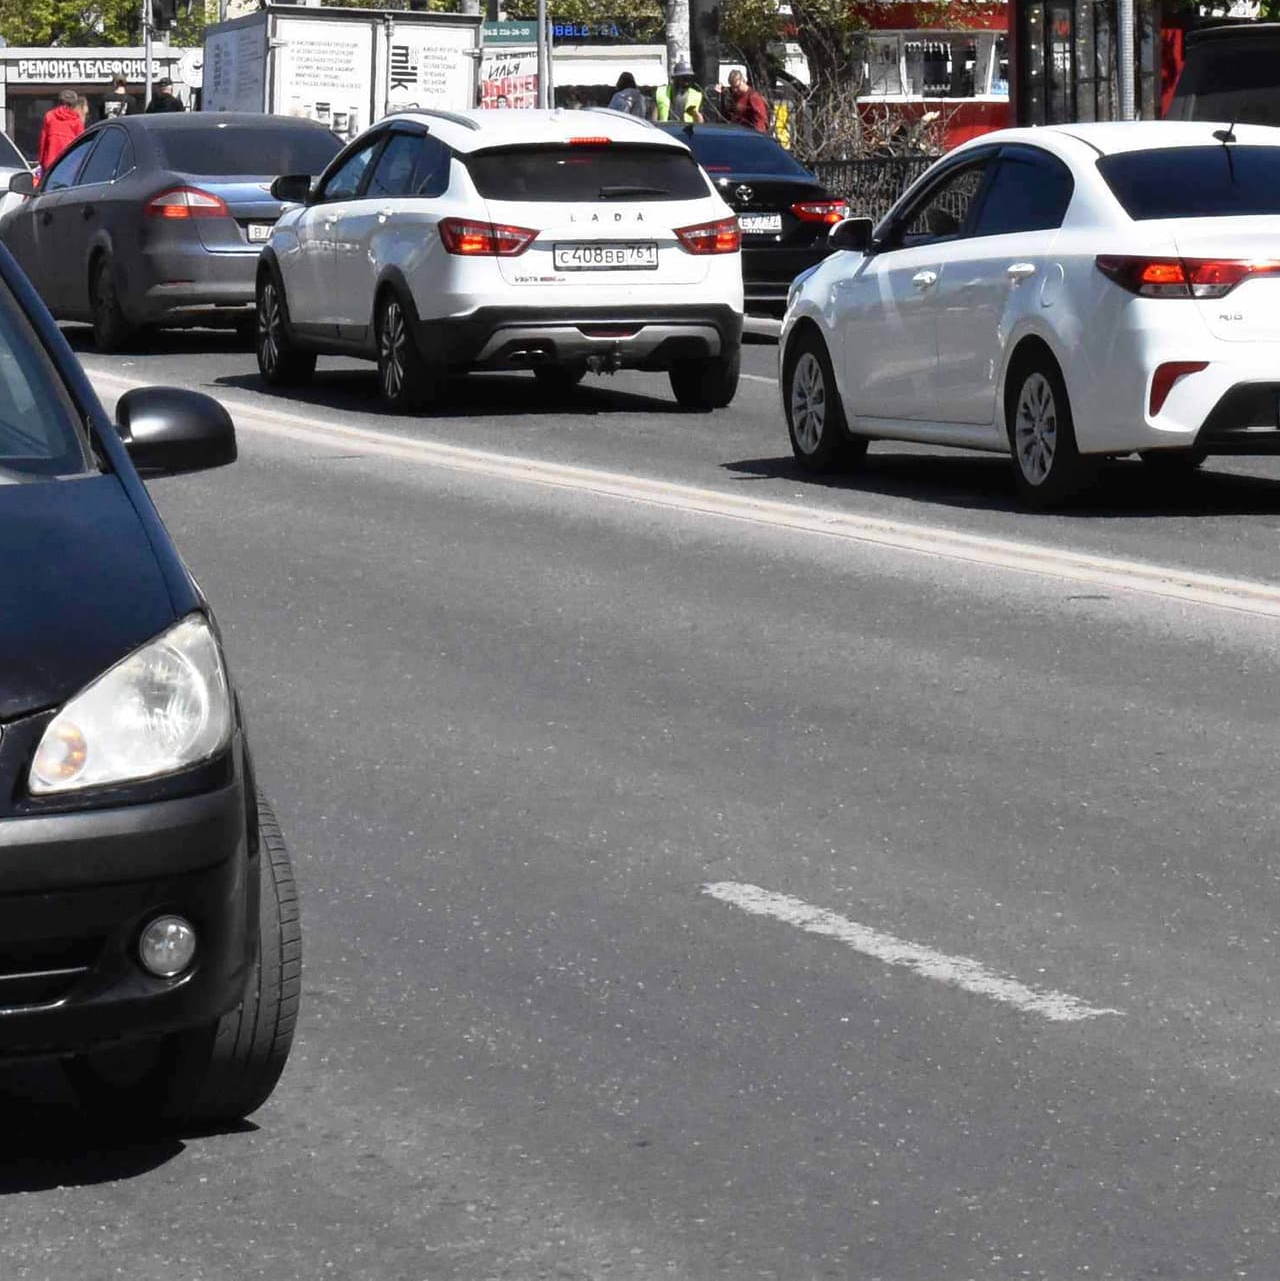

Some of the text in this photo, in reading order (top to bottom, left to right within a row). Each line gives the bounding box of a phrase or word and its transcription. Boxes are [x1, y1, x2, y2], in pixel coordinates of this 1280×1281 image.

[18, 60, 77, 75] РЕМОНТ
[391, 45, 418, 91] milk
[569, 212, 644, 223] LADA
[560, 245, 653, 264] С408ВВ 761
